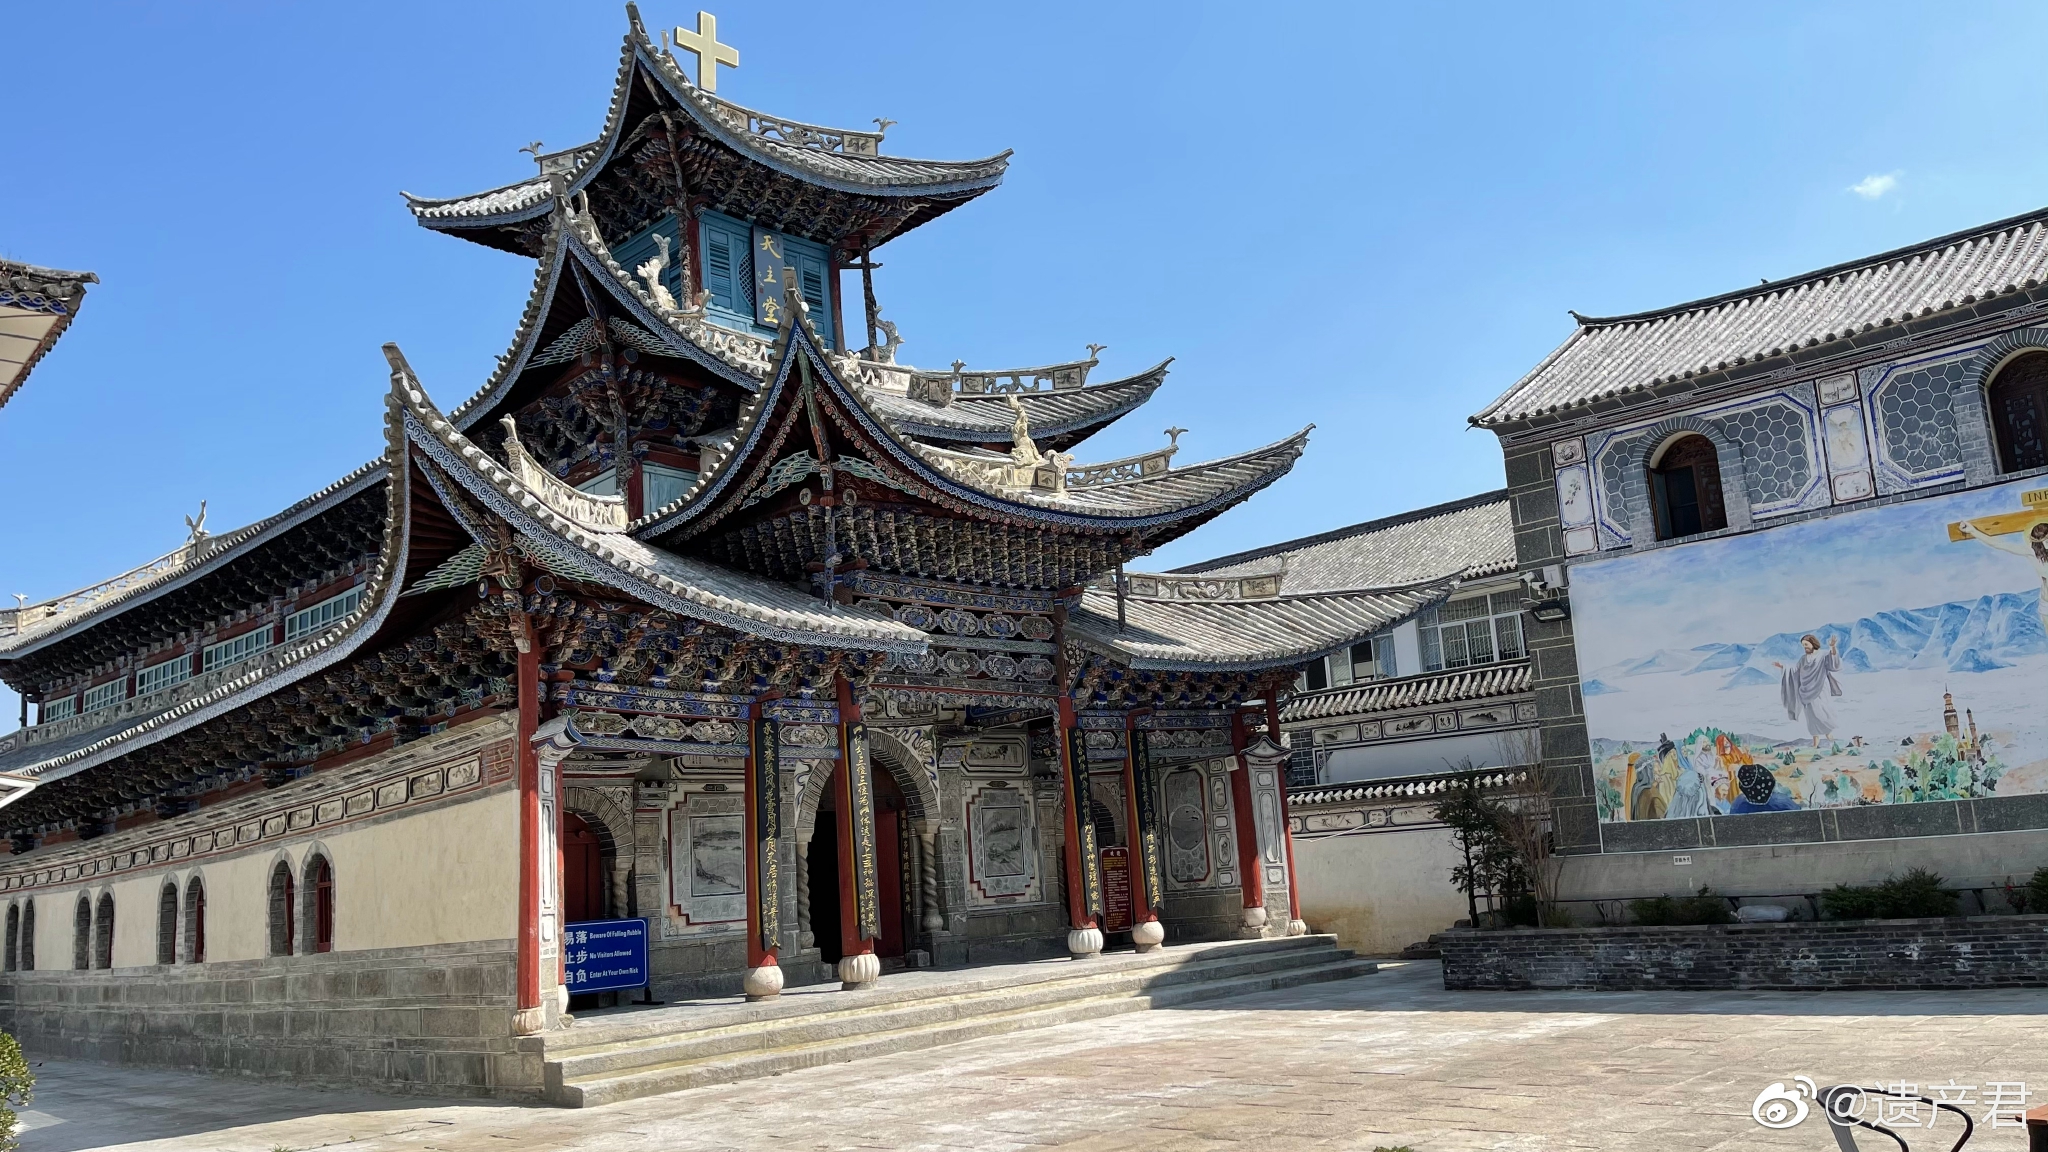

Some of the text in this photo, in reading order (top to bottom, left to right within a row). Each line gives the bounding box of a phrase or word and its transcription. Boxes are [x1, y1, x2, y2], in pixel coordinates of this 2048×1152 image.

[760, 235, 782, 324] 天主堂
[564, 930, 588, 946] 易落
[612, 930, 626, 938] Falling
[627, 929, 642, 937] Rubble
[564, 949, 588, 965] 止步
[597, 951, 613, 959] Visitors
[614, 949, 632, 957] Allowed
[564, 968, 588, 985] 自负
[590, 971, 602, 979] Enter
[602, 969, 608, 977] At
